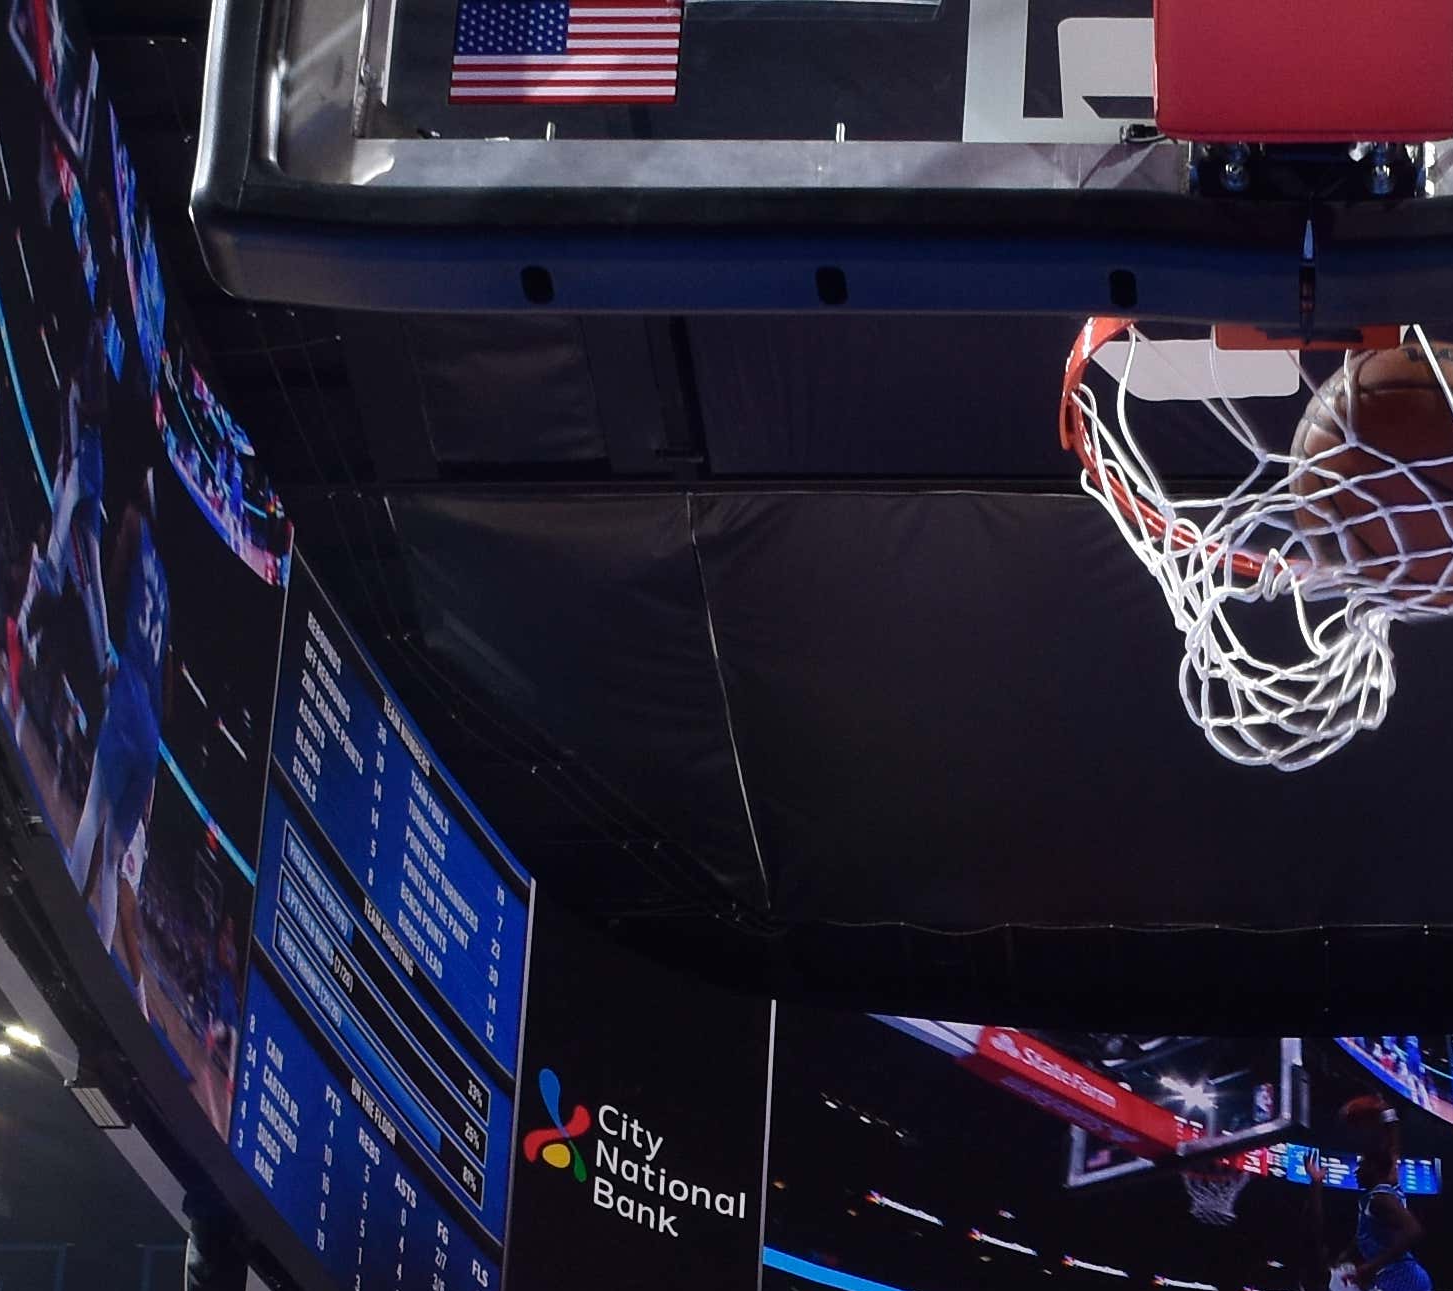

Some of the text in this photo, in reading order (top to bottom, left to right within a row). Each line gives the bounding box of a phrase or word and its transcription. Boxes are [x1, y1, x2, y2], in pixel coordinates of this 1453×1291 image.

[596, 1105, 665, 1162] City
[325, 1085, 342, 1116] PTS
[358, 1127, 381, 1165] REBS
[394, 1173, 416, 1208] ASTS
[472, 1259, 488, 1288] FLS
[592, 1178, 680, 1240] Bank
[595, 1139, 747, 1221] National
